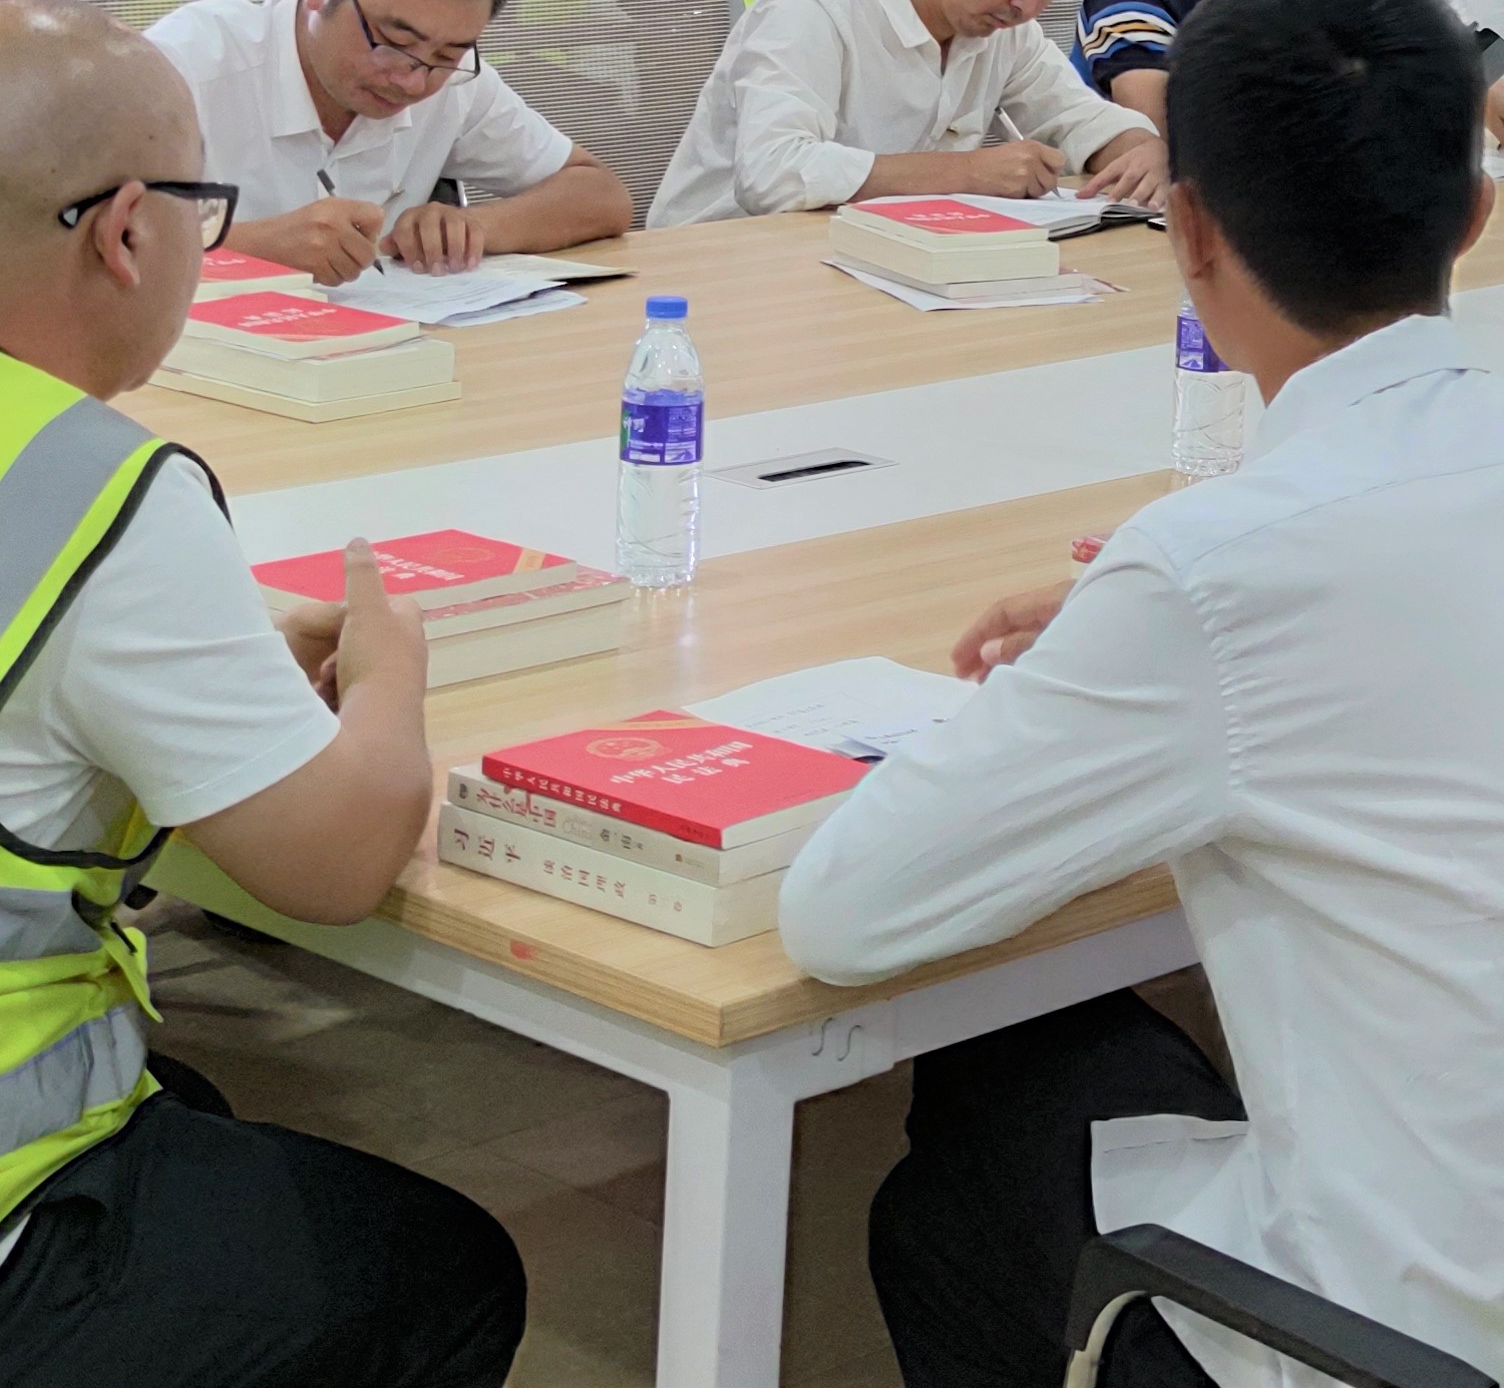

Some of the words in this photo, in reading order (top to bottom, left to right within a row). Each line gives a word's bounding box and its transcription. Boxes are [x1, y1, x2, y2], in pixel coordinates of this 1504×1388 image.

[502, 765, 624, 814] 中华人民共和国民法典
[453, 827, 522, 864] 习近平
